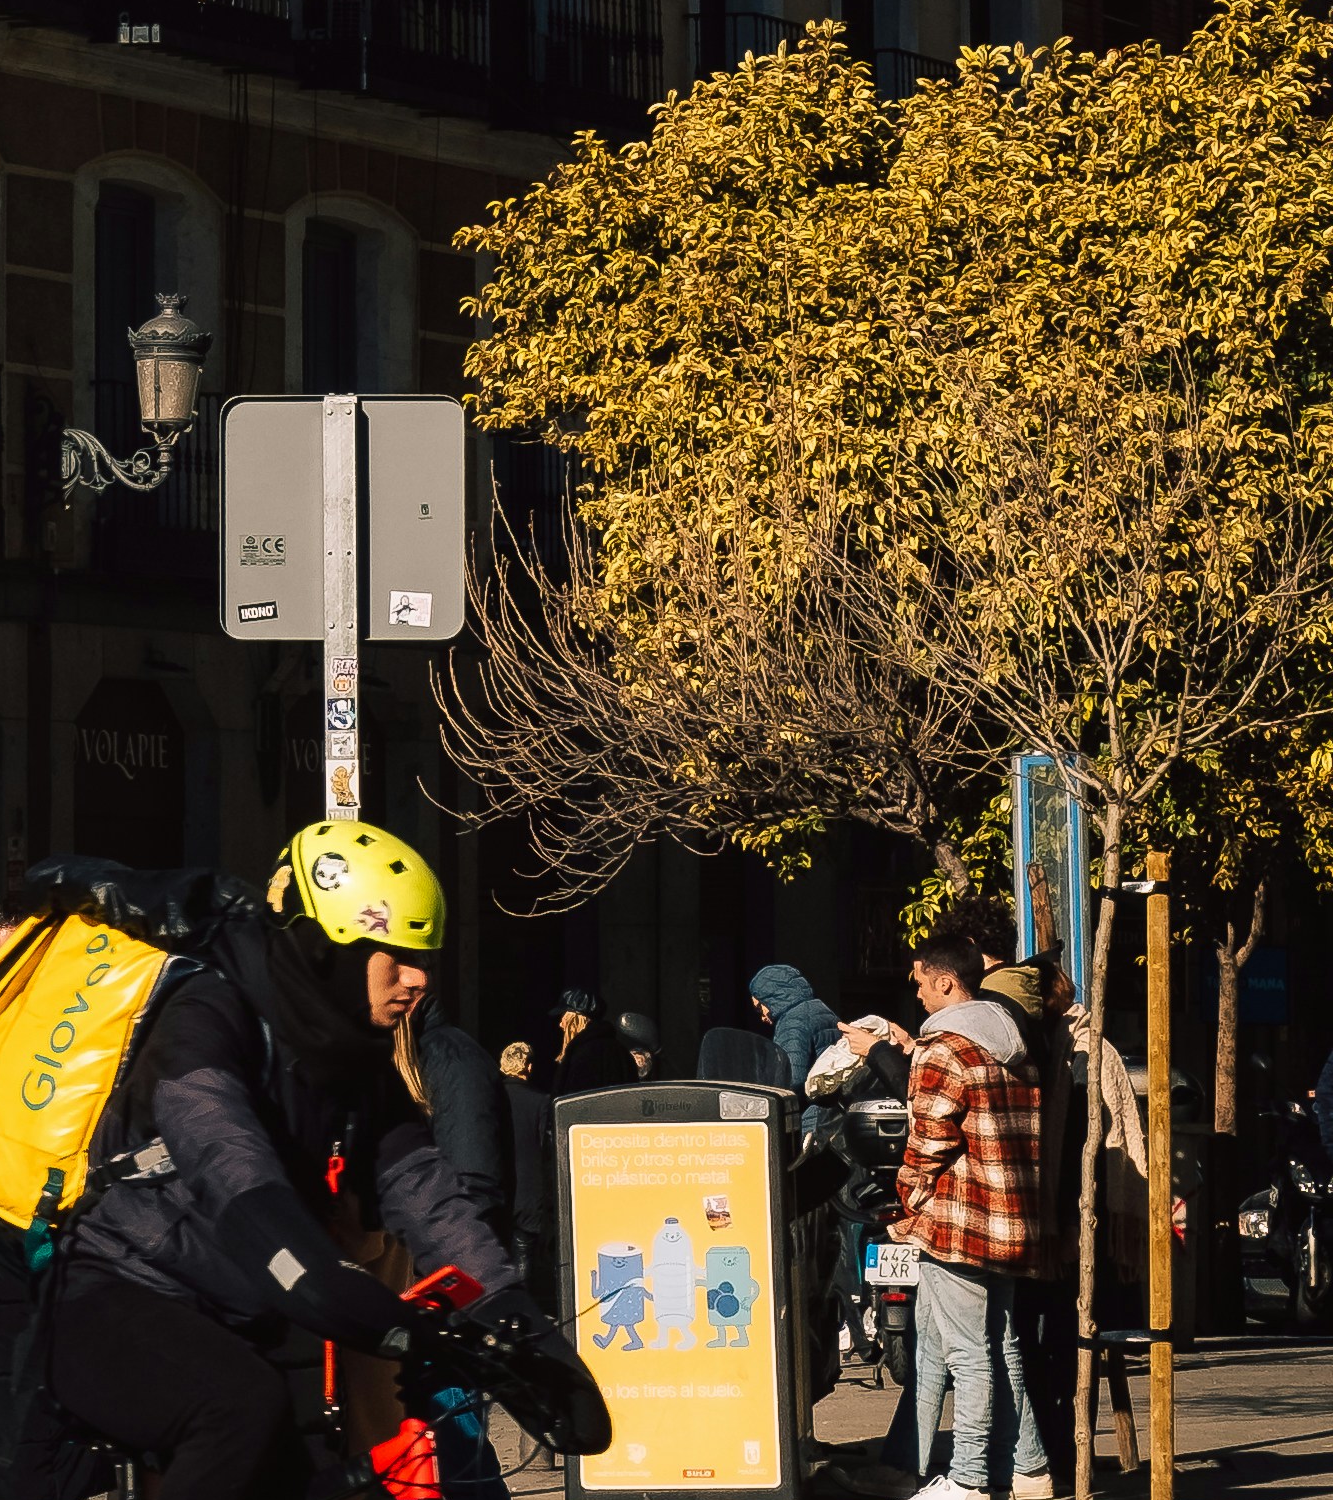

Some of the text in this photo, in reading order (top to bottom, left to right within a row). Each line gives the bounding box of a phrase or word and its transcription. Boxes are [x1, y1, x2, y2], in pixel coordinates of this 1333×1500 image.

[80, 724, 169, 781] VOLAPIÉ
[580, 1132, 750, 1149] Deposita dentro latas,
[581, 1152, 745, 1171] briks y otros envases
[582, 1169, 732, 1189] de plástico o metal.
[880, 1248, 920, 1263] 4425
[879, 1263, 910, 1279] LXR
[616, 1383, 640, 1399] los
[643, 1383, 677, 1398] tires
[680, 1383, 694, 1398] al
[698, 1383, 743, 1398] suelo.
